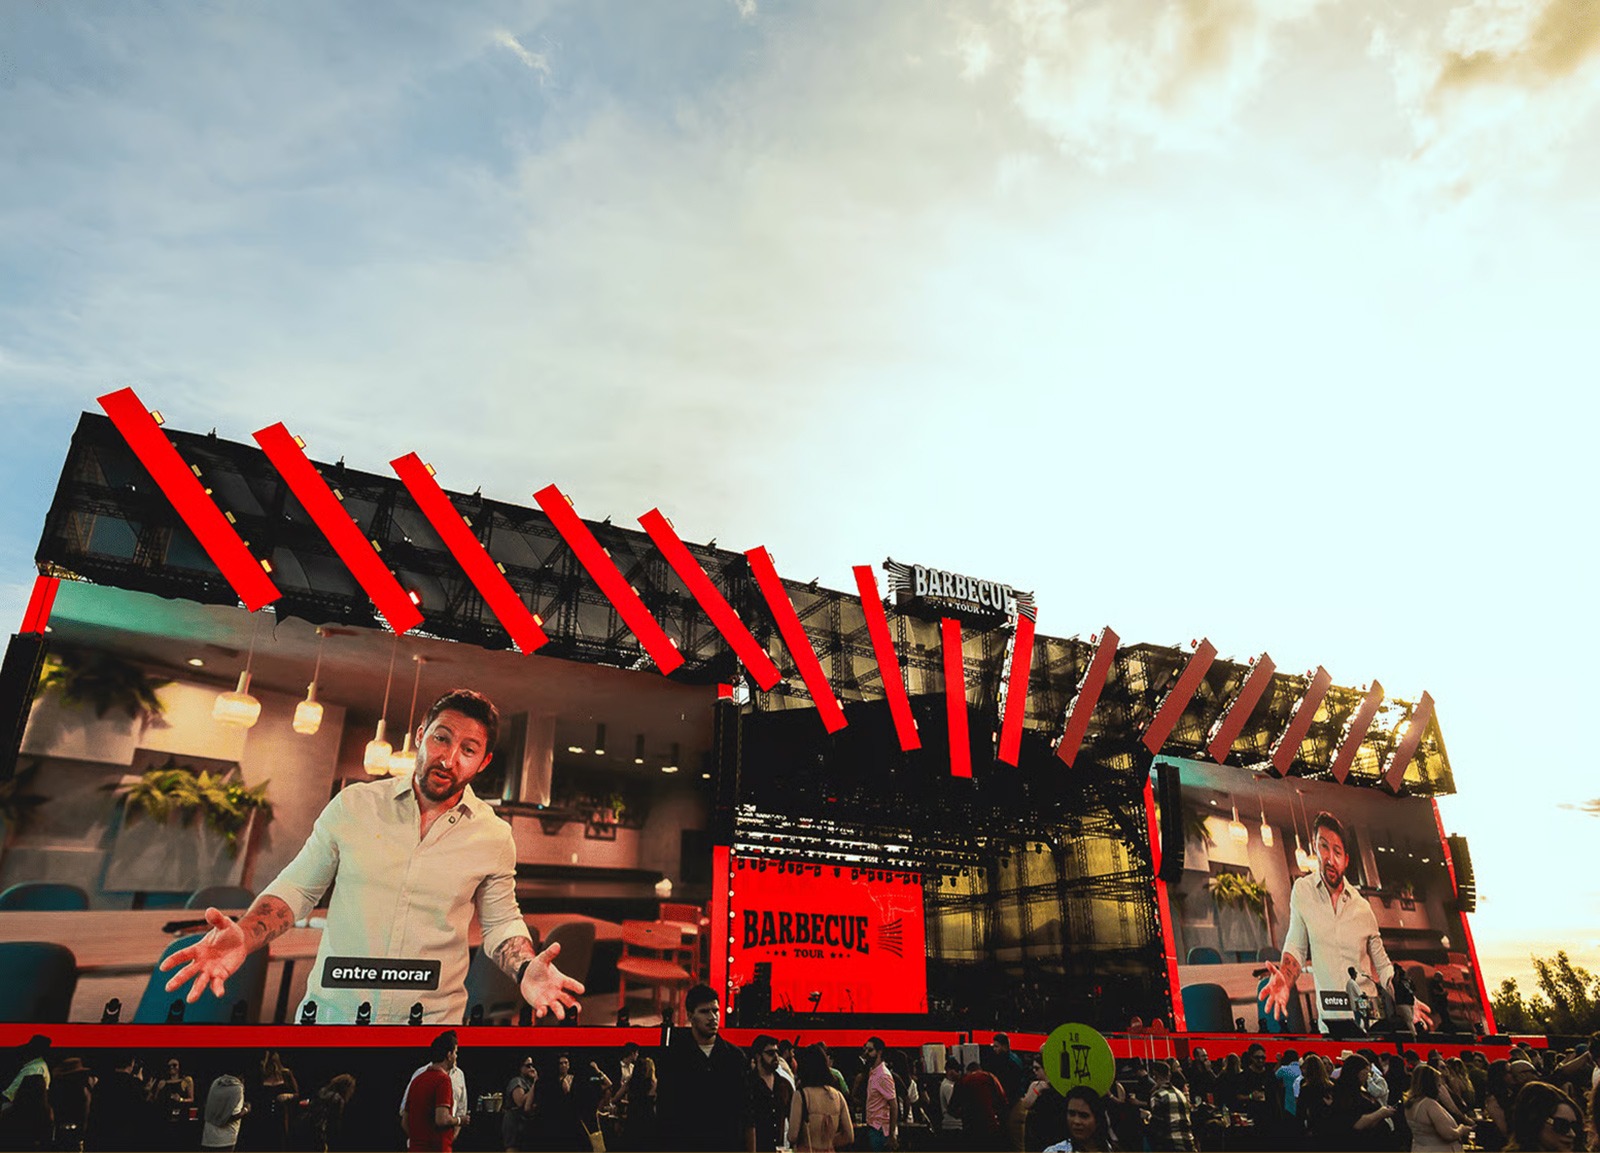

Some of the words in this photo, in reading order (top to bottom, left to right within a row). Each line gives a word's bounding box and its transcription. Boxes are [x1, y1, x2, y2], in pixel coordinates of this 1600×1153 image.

[914, 564, 1016, 616] BARBECUE
[955, 602, 980, 615] TOUR
[743, 909, 869, 955] BARBECUE
[794, 949, 824, 959] TOUR
[332, 967, 377, 980] entre
[381, 969, 431, 981] morar
